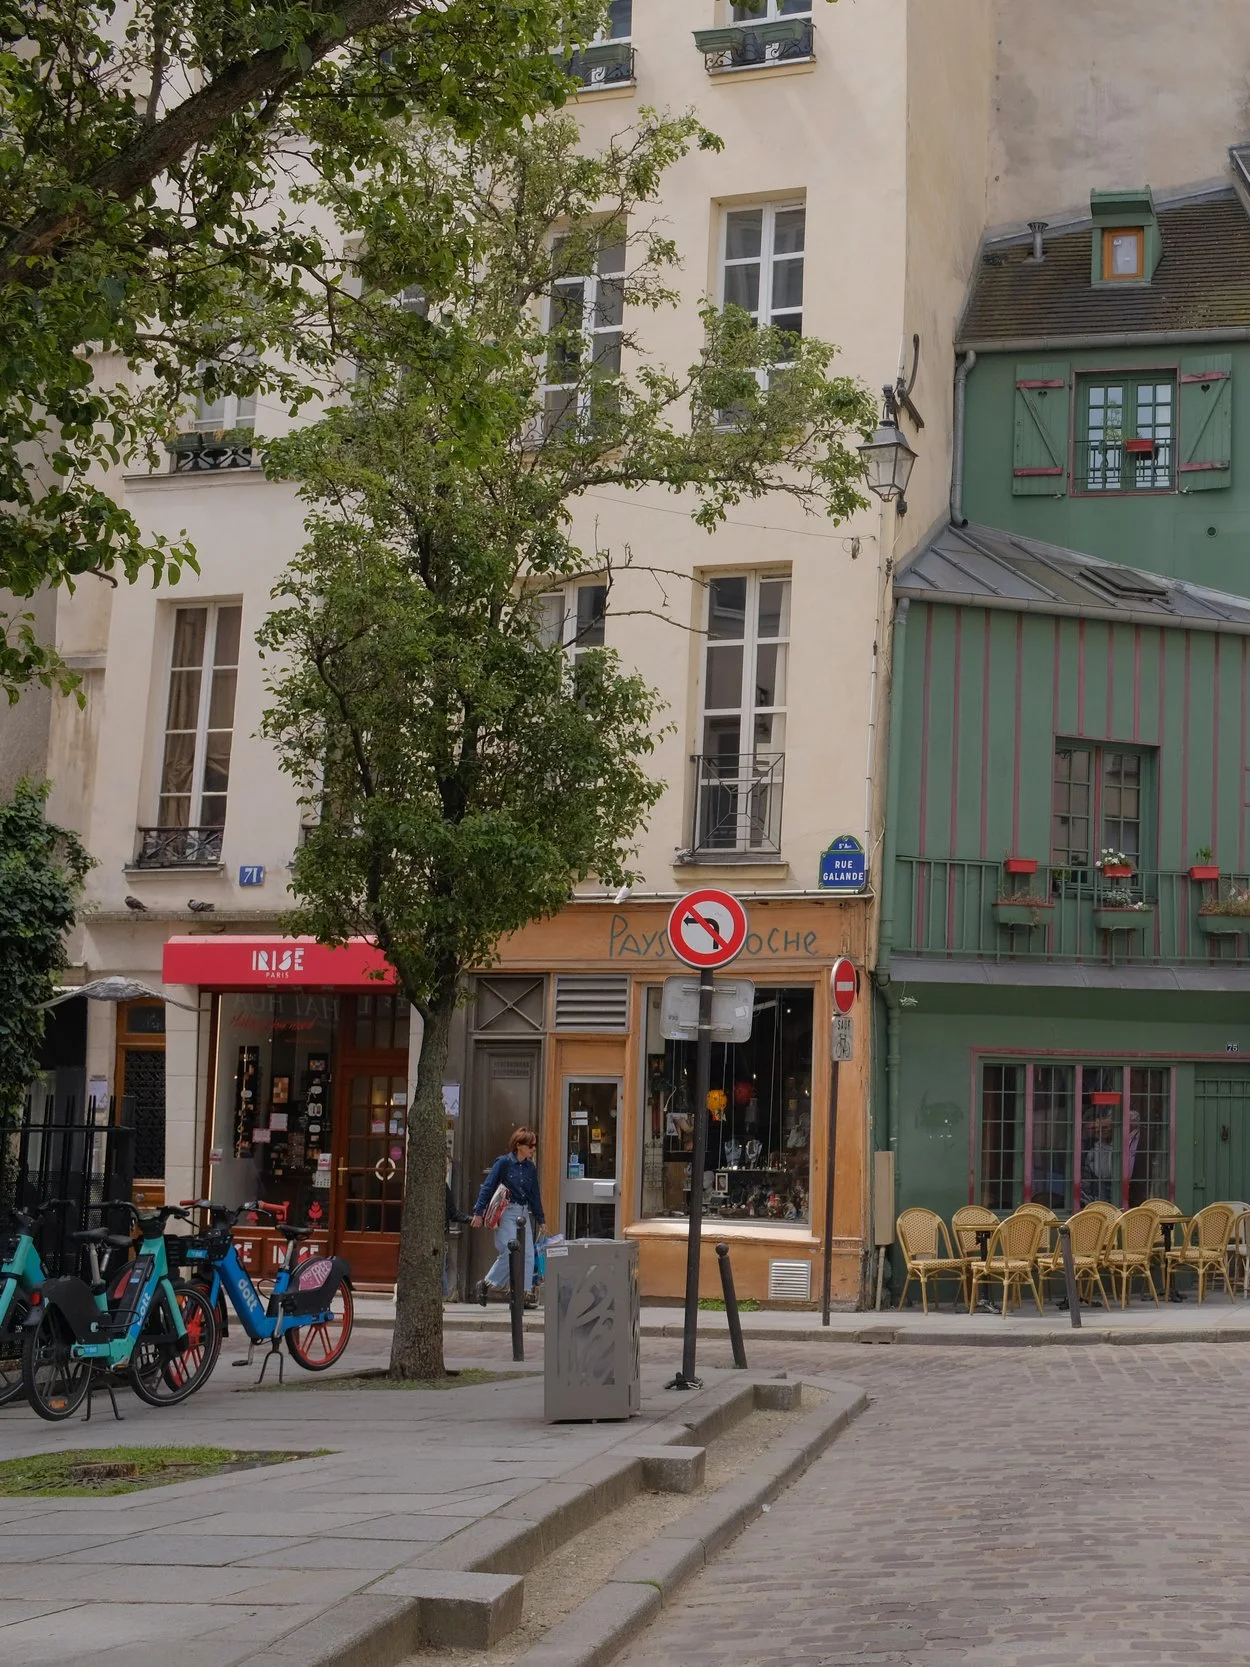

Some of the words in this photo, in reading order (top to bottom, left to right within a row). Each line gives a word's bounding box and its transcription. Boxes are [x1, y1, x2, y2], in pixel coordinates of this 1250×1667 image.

[834, 860, 853, 869] RUE
[243, 867, 258, 883] 71
[822, 872, 864, 881] GALANDE
[837, 1019, 851, 1030] SAUF
[238, 1278, 259, 1313] dott
